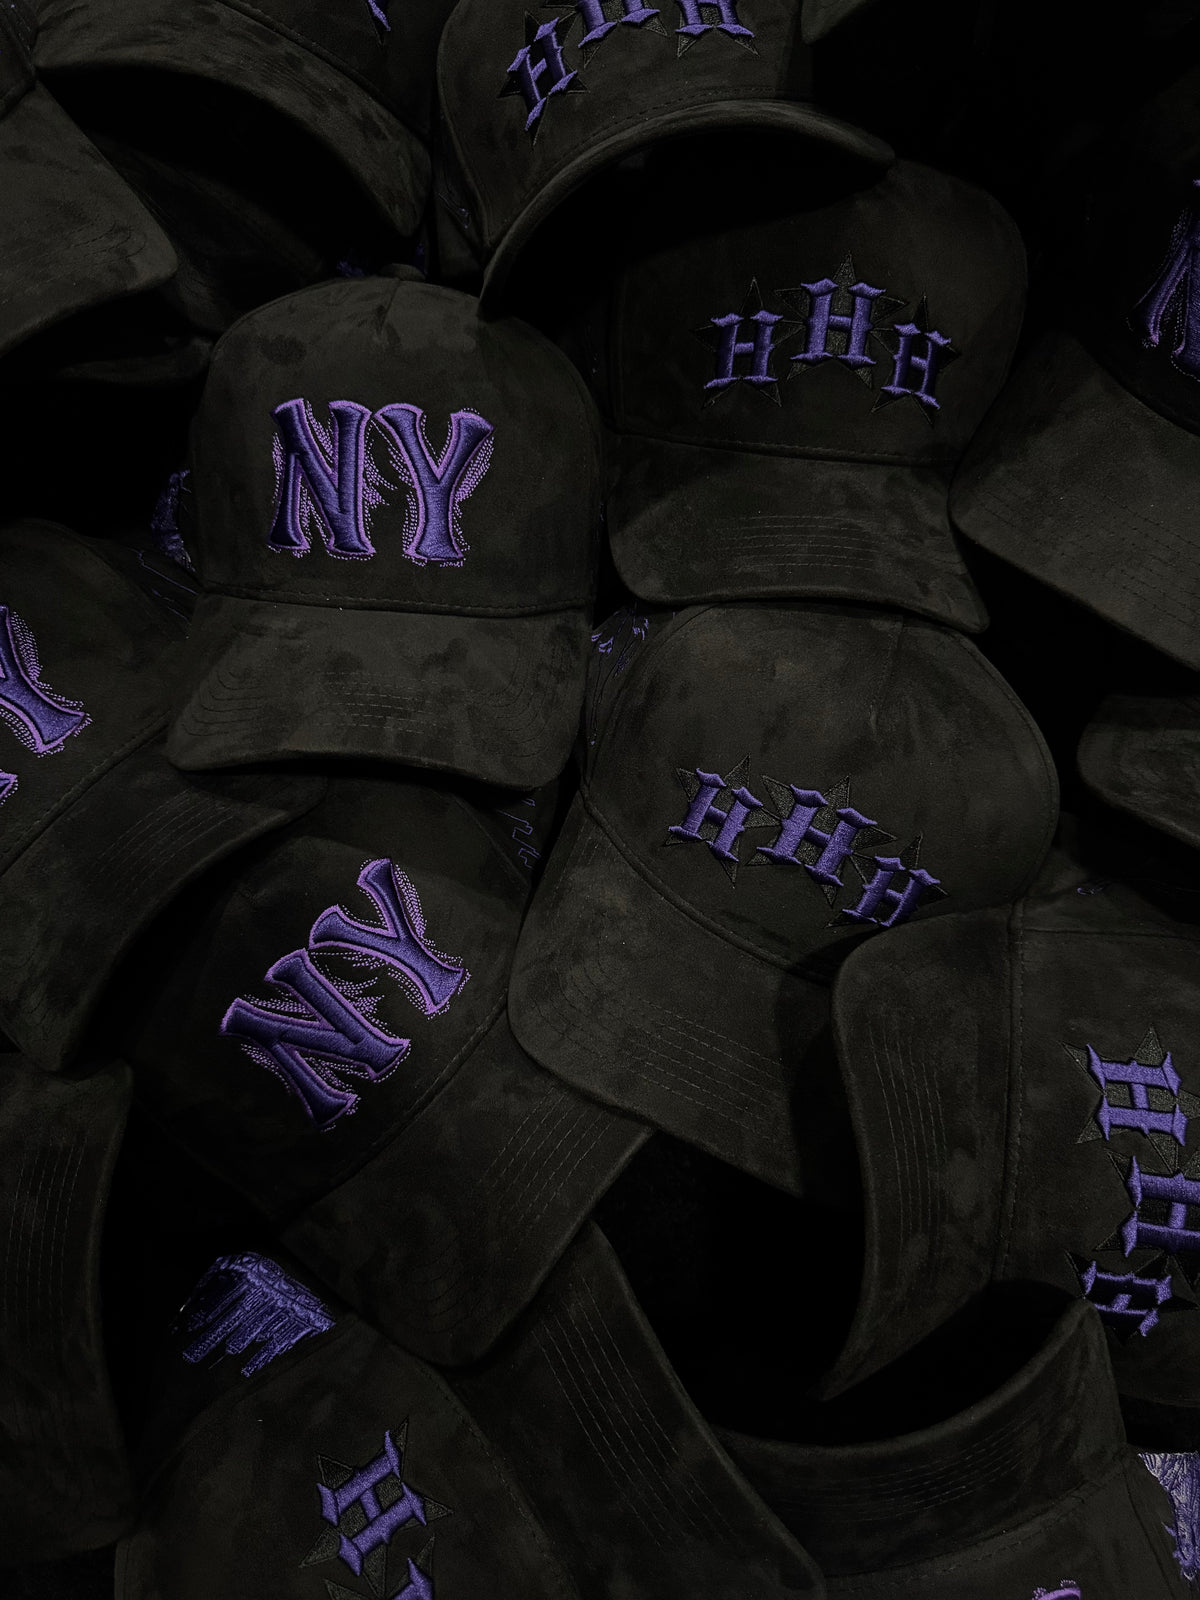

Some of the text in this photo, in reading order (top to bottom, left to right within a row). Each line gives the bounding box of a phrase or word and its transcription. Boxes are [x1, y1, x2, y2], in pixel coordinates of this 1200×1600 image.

[704, 278, 951, 409] HHH
[267, 398, 494, 567] NY
[668, 768, 941, 927] HHH
[218, 858, 471, 1132] NY
